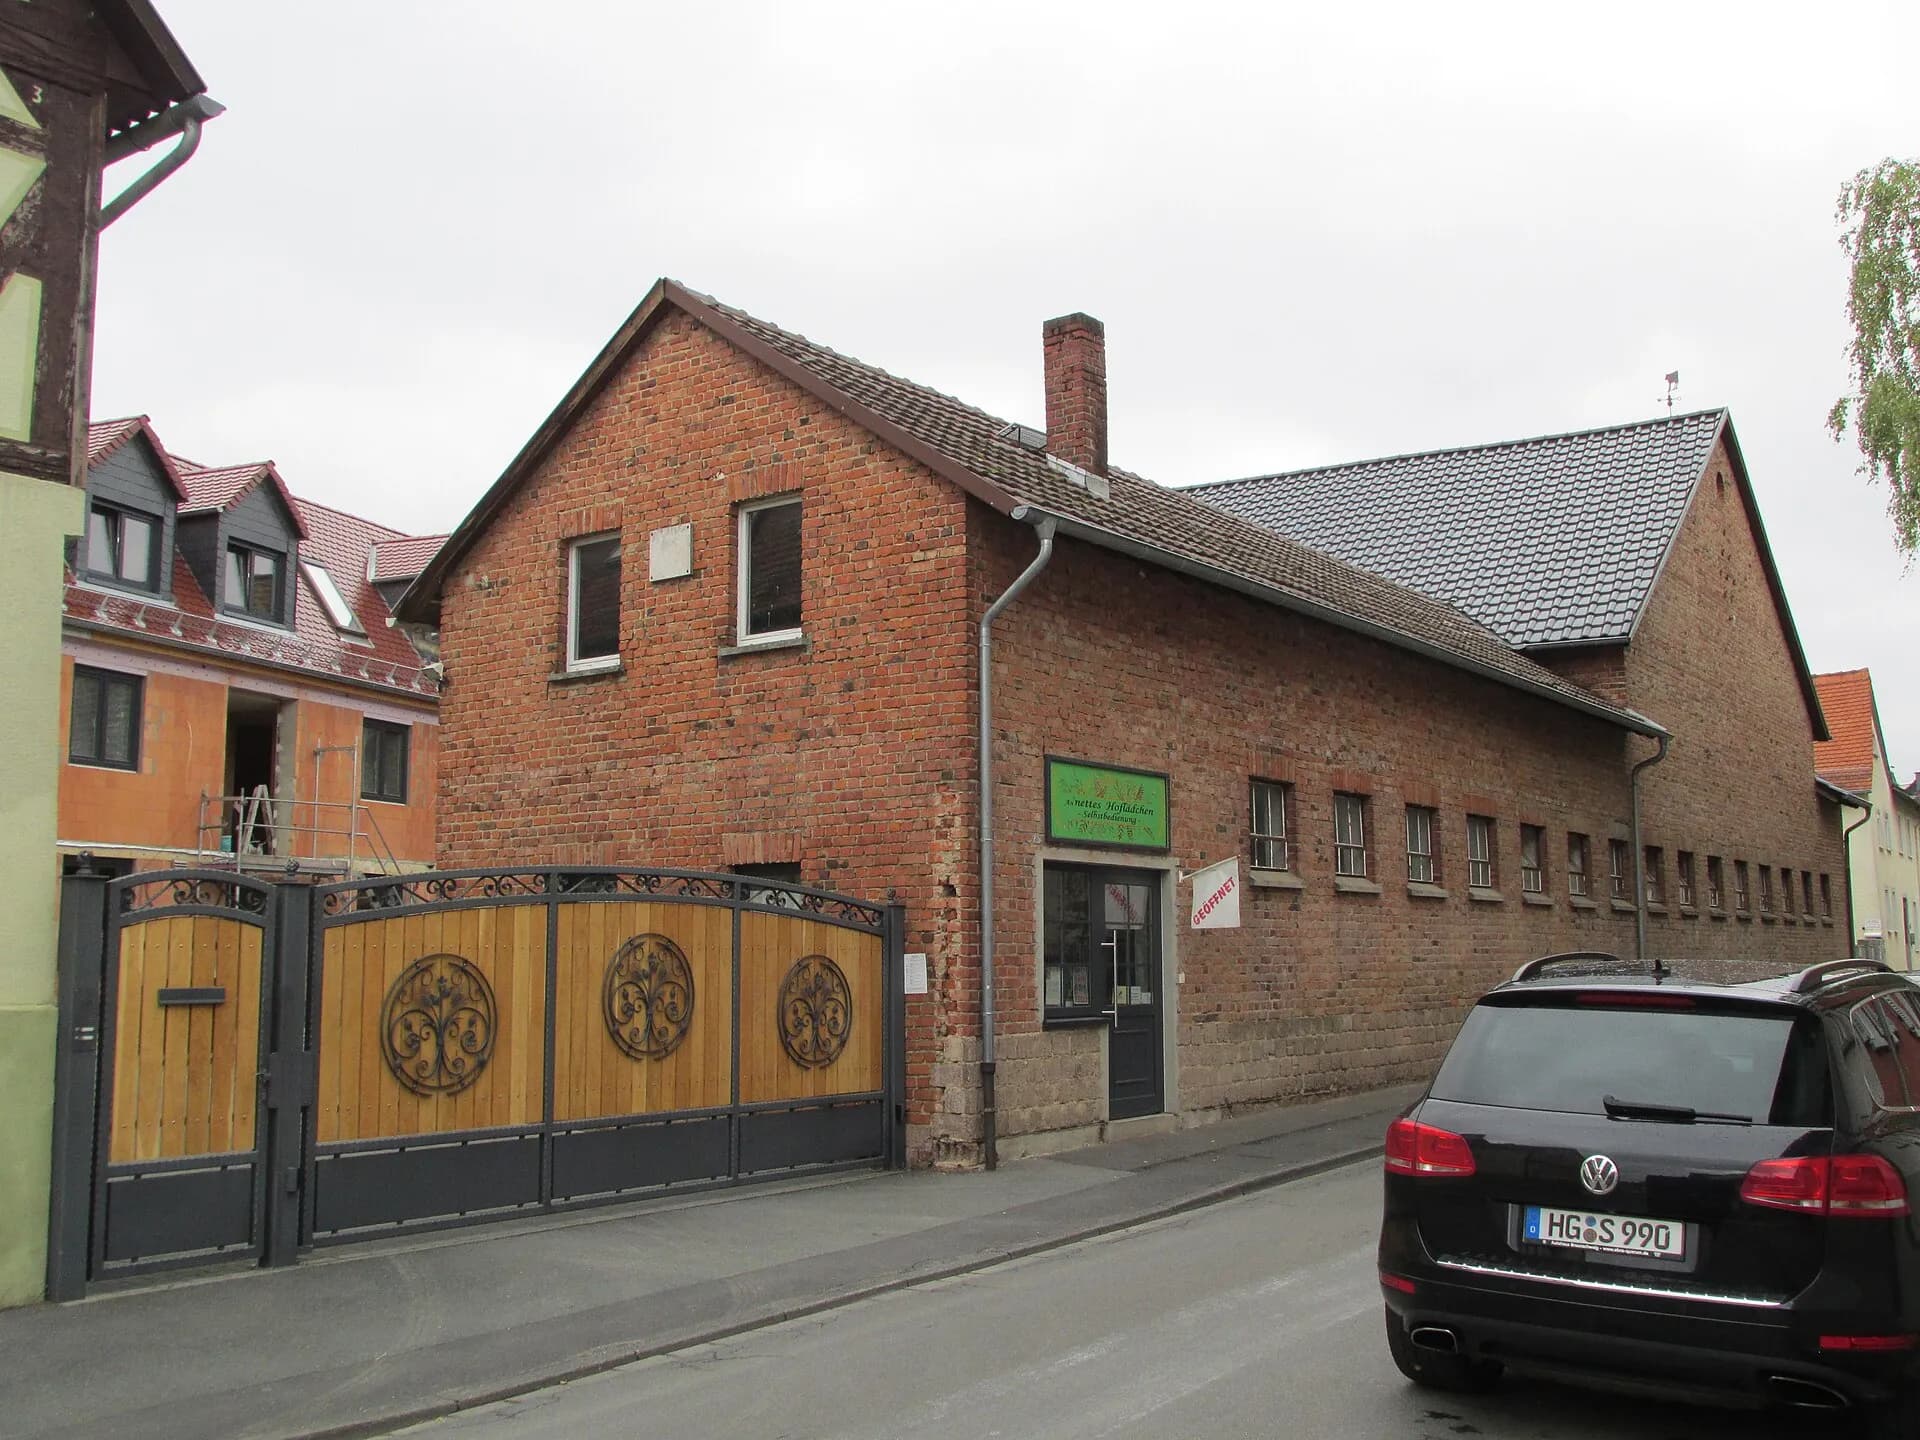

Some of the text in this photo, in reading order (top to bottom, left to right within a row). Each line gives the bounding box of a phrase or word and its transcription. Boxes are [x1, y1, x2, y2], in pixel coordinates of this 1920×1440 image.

[32, 85, 42, 103] 3
[1193, 876, 1235, 925] GEÖFFNET
[1548, 1212, 1670, 1250] HG S 990
